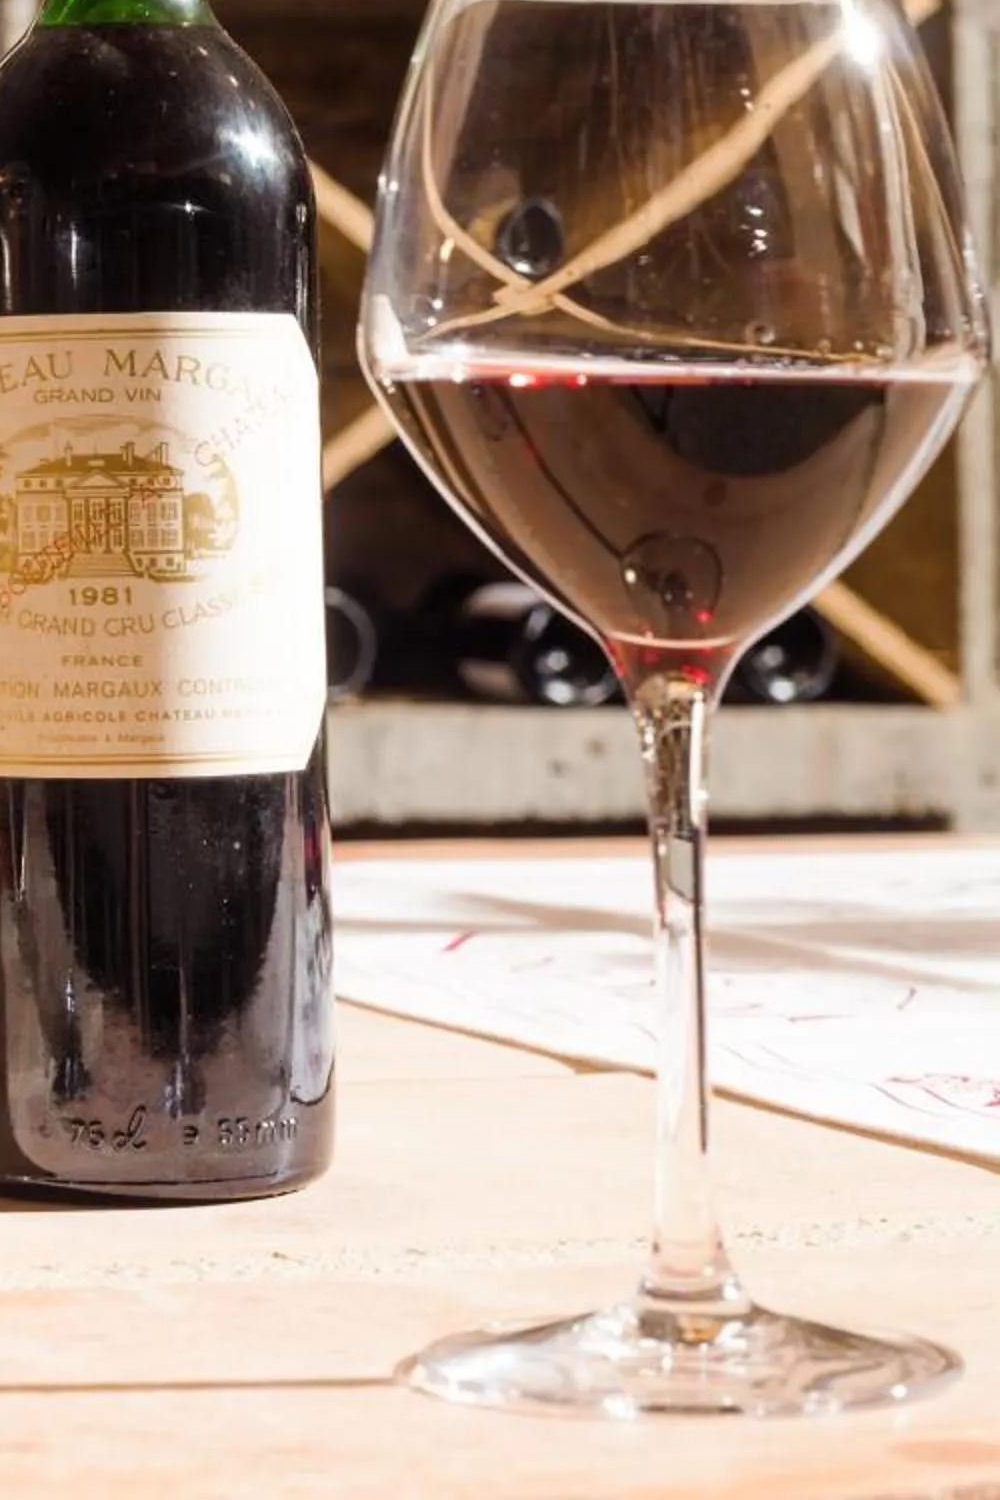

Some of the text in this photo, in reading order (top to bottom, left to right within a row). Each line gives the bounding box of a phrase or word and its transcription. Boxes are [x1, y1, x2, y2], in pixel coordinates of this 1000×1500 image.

[103, 348, 264, 406] MARGA
[32, 386, 162, 405] GRAND VIN
[68, 586, 133, 607] 1981
[17, 607, 97, 638] GRAND
[103, 612, 155, 638] CRU
[61, 653, 145, 668] FRANCE
[53, 679, 163, 699] MARGAUX
[134, 707, 216, 723] CHATEAU
